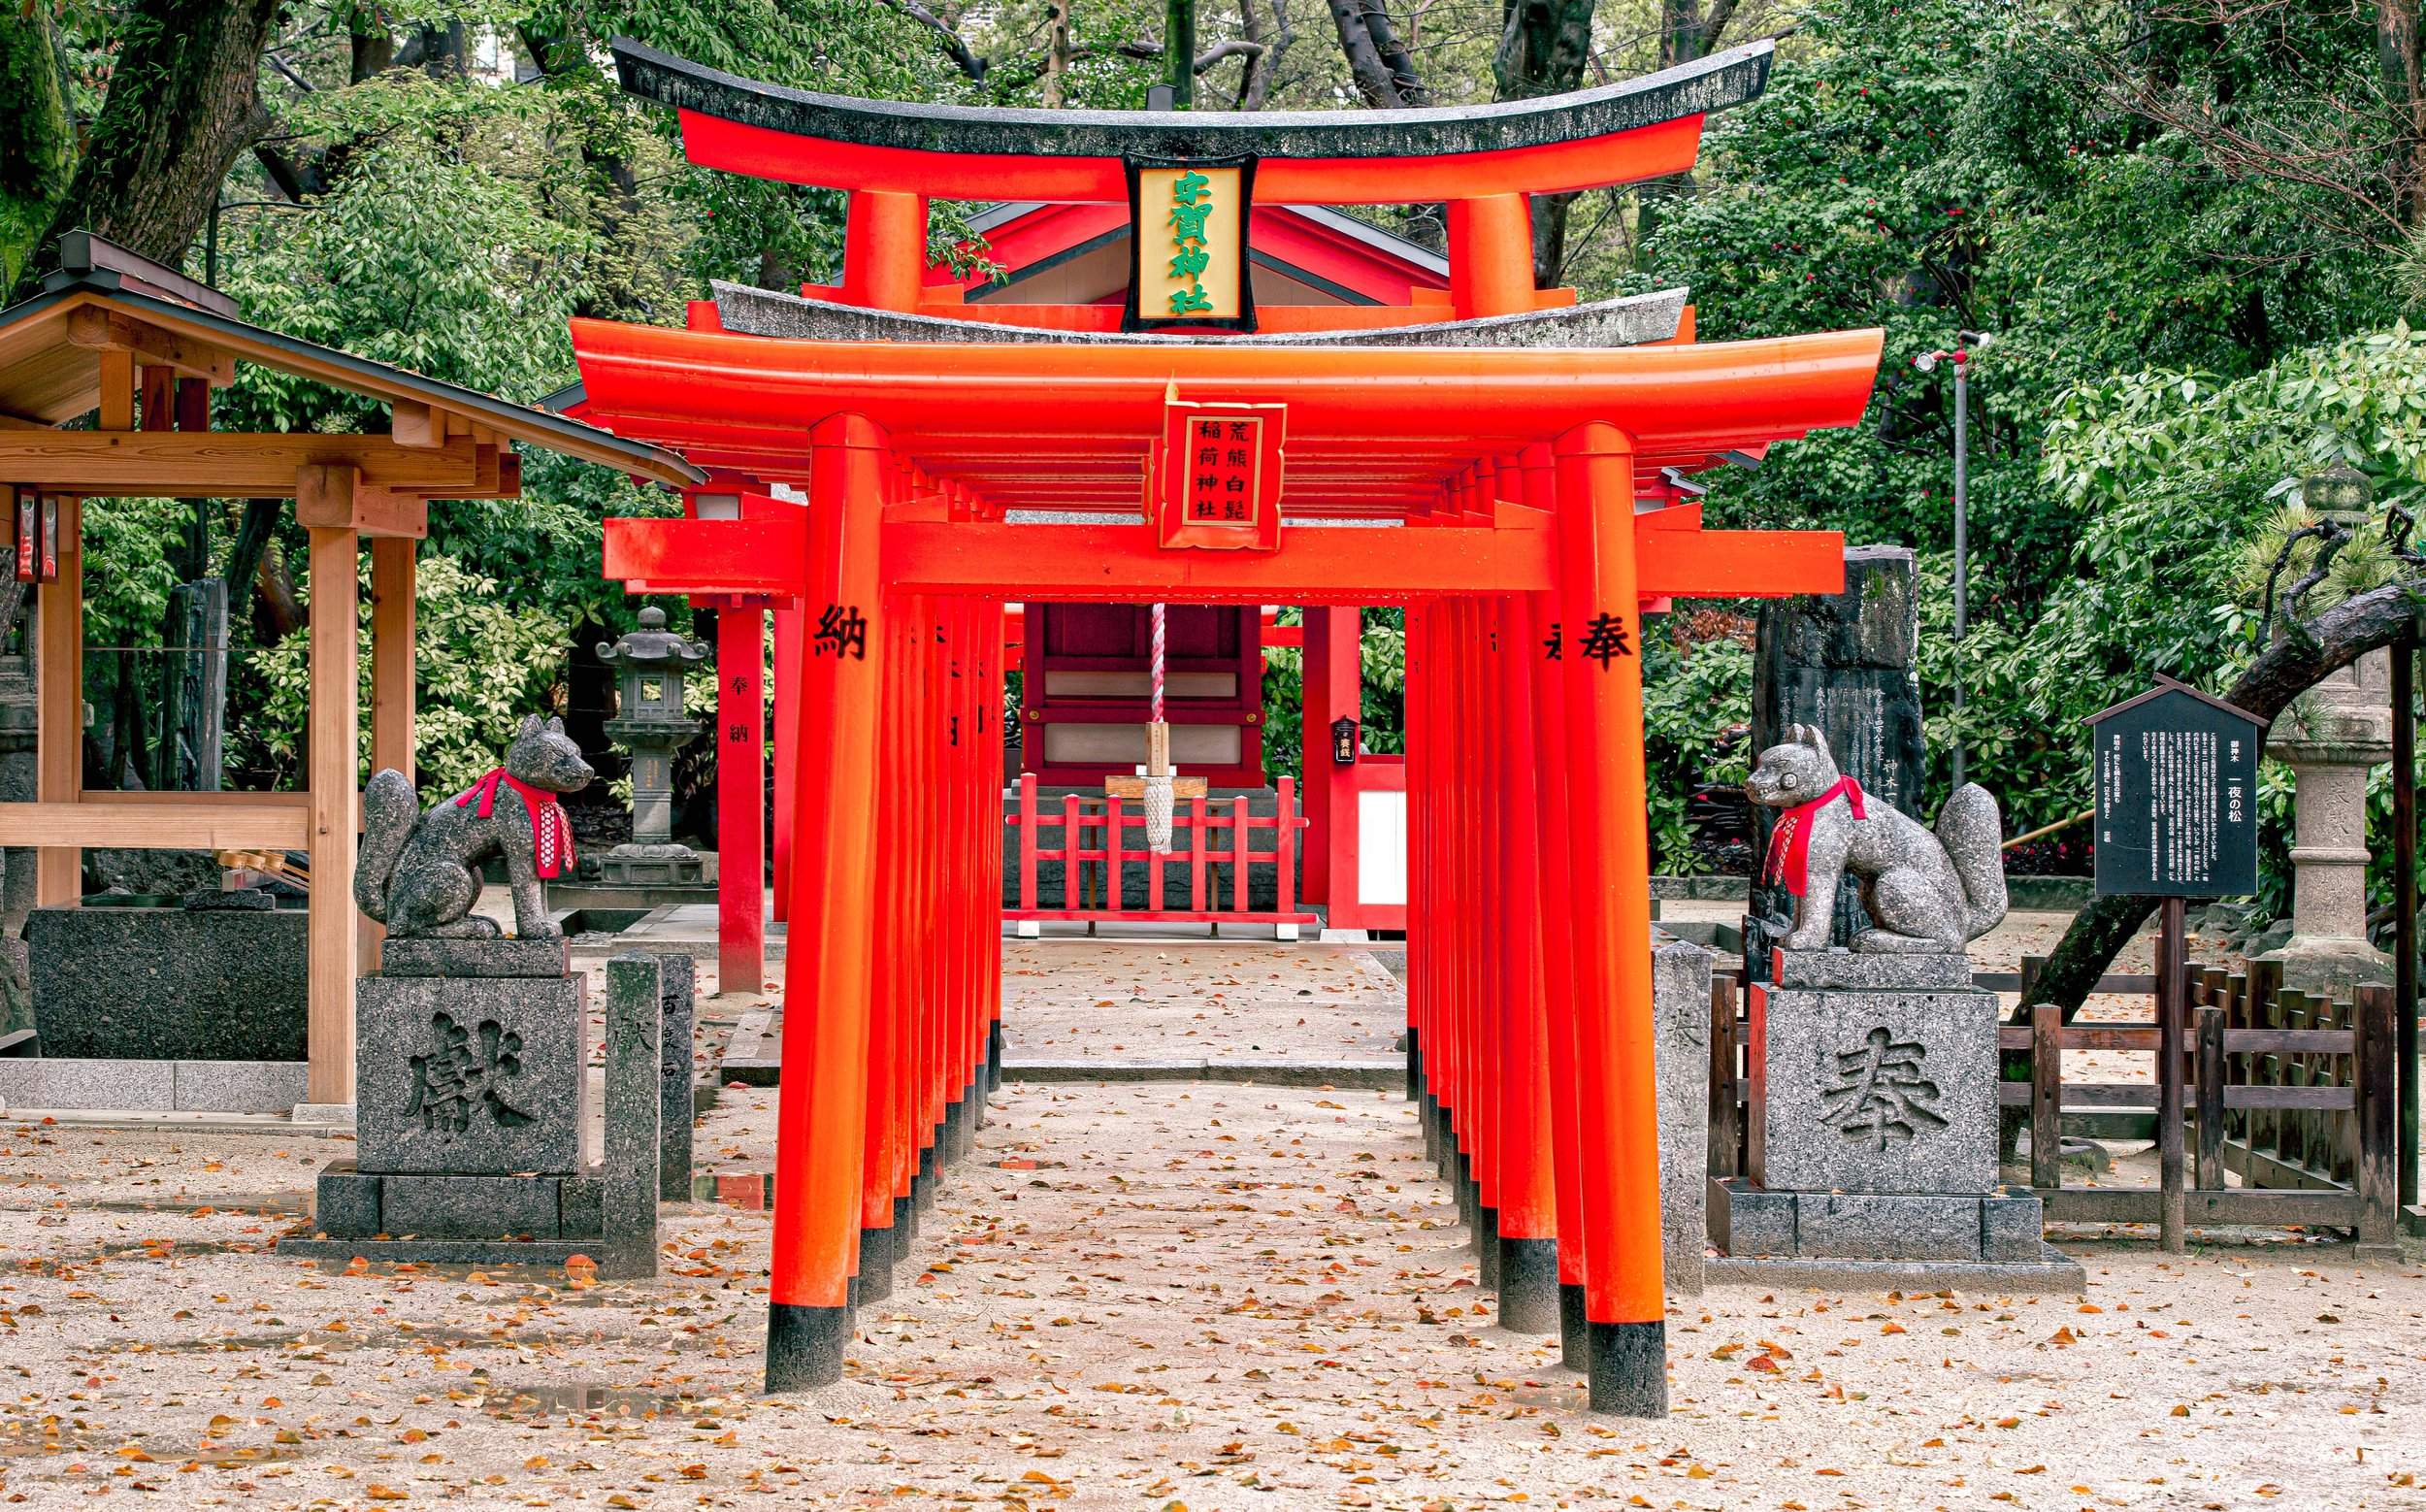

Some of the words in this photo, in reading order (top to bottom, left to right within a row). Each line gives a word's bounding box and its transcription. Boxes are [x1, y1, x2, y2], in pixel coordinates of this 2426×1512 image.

[1167, 171, 1213, 314] 宇賀神社
[1197, 420, 1221, 517] 稲荷神社
[813, 604, 867, 660] 納
[1578, 612, 1632, 673] 奉
[730, 675, 748, 742] 奉納
[2228, 778, 2241, 822] 一夜の松
[1819, 1027, 1949, 1152] 奉
